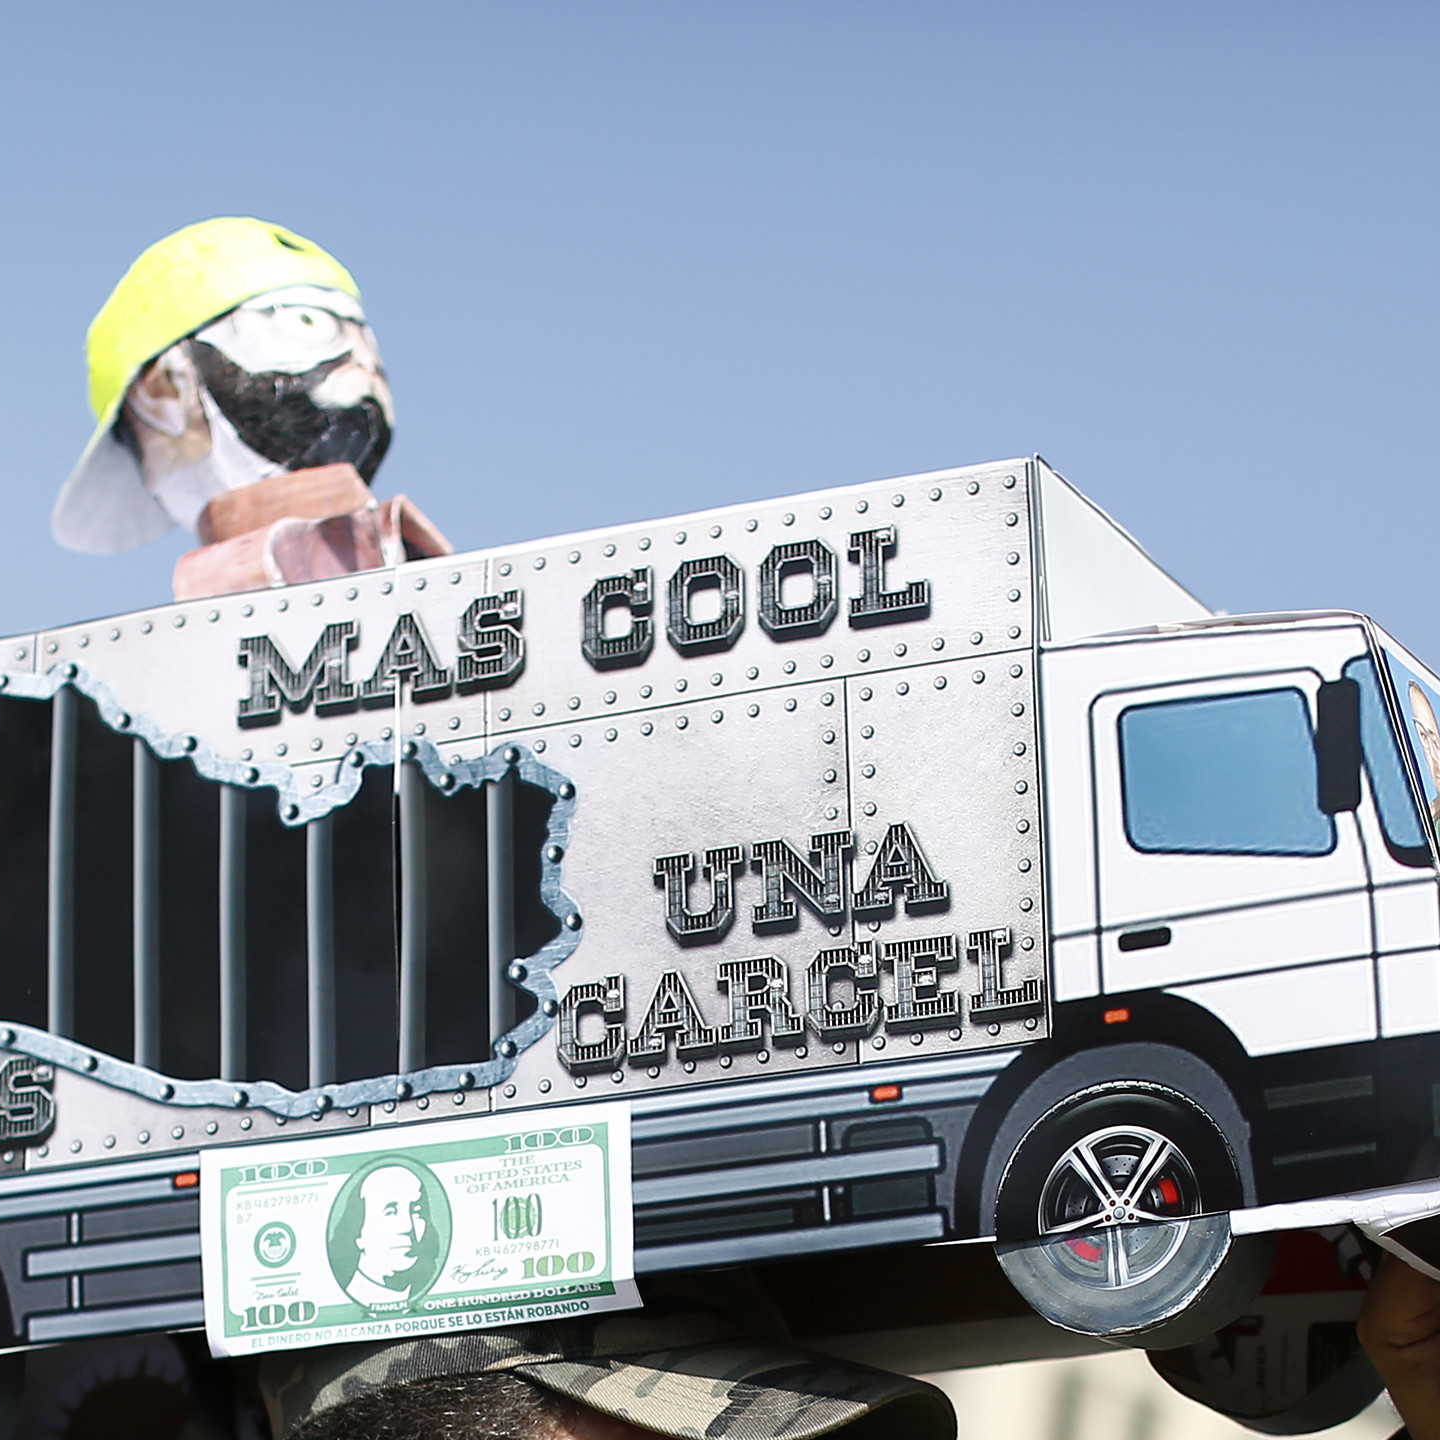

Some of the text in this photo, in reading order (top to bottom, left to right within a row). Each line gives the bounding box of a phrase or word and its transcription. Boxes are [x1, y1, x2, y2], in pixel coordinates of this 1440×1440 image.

[236, 523, 932, 729] MAS COOL
[651, 821, 952, 944] UNA
[557, 926, 1045, 1073] CARCEL
[504, 1126, 595, 1154] 100
[239, 1159, 329, 1185] 100
[453, 1159, 583, 1185] UNITED STATES
[499, 1154, 536, 1168] THE
[466, 1173, 572, 1194] OF AMERICA
[492, 1193, 543, 1242] 100
[521, 1251, 596, 1280] 100
[370, 1301, 408, 1313] FRANKLIN
[423, 1283, 602, 1311] ONE HUNDRED DOLLARS
[242, 1301, 318, 1331] 100
[251, 1300, 591, 1349] EL DINERO NO ALCANZA PORQUE SE LO ESTÁN ROBANDO
